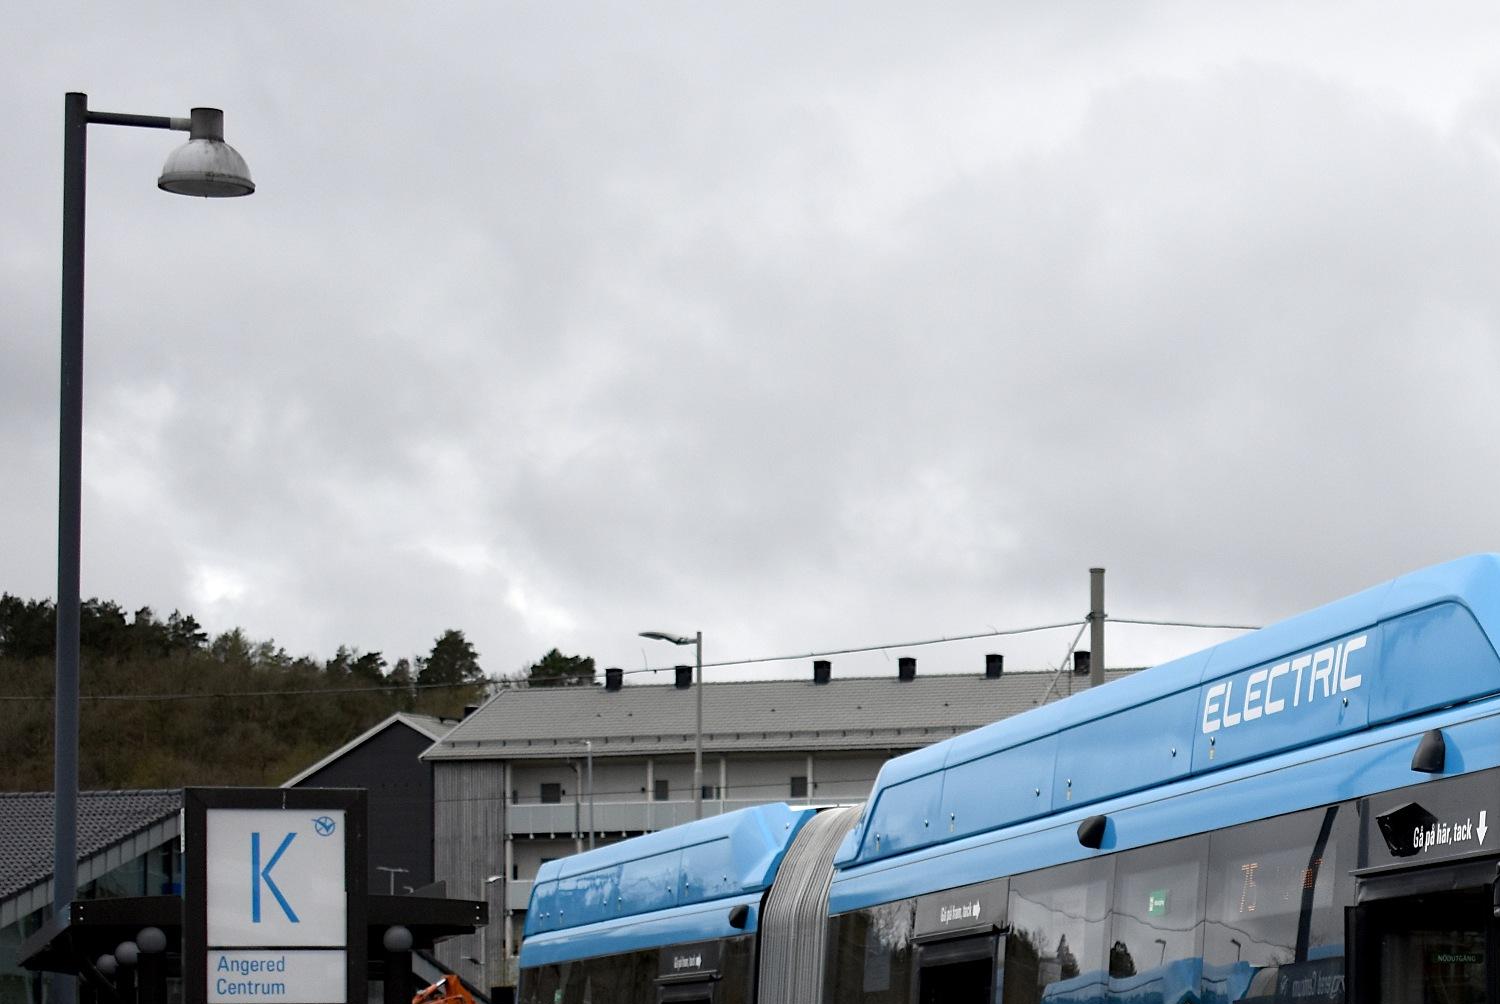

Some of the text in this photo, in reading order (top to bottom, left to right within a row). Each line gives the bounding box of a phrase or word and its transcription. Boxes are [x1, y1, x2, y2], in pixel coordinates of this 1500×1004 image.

[1202, 635, 1367, 734] ELECTRIC
[1413, 818, 1472, 853] Gå på här, tack
[251, 832, 300, 923] K
[217, 956, 285, 975] Angered
[216, 979, 285, 996] Centrum
